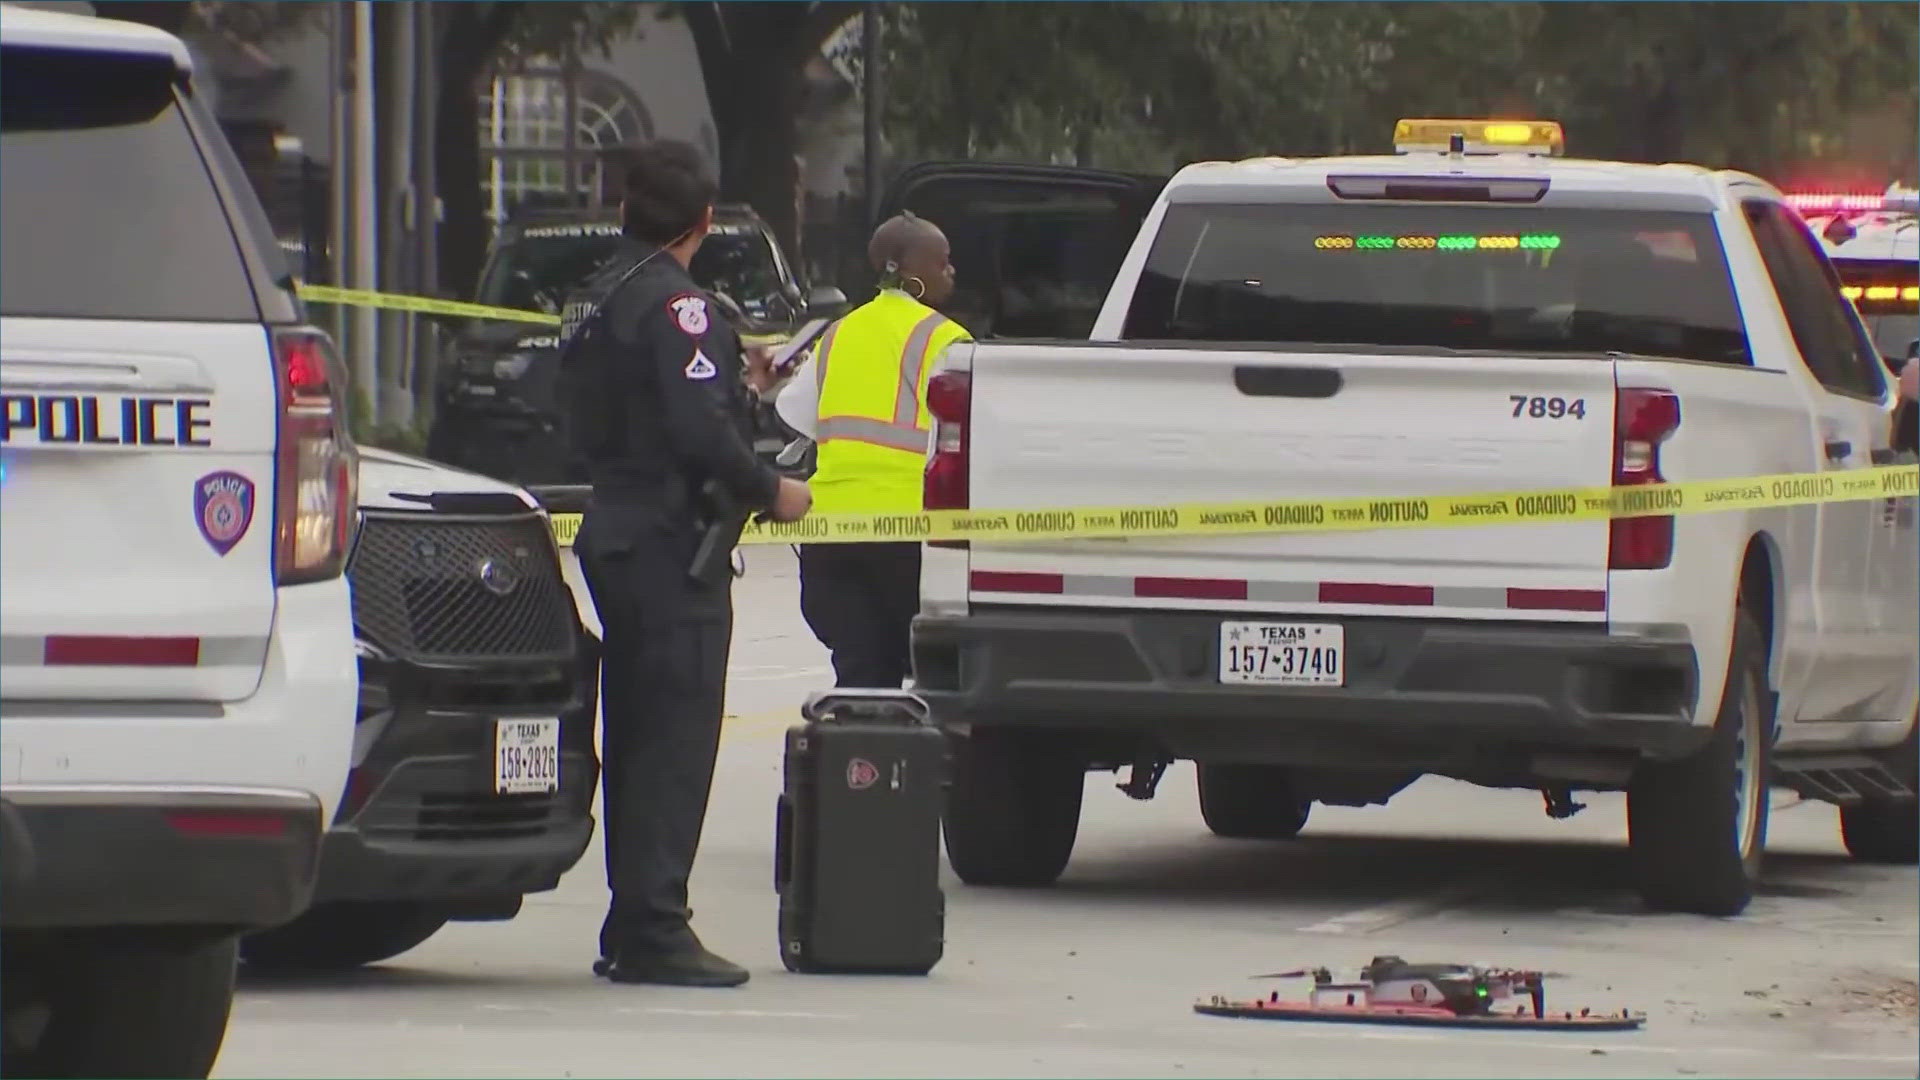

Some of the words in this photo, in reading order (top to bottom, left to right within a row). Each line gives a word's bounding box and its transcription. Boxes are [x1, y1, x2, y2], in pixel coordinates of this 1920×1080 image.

[1509, 394, 1586, 420] 7894
[0, 396, 211, 446] POLICE
[203, 476, 246, 498] POLICE
[1260, 626, 1306, 640] TEXAS
[518, 723, 540, 738] TEXAS
